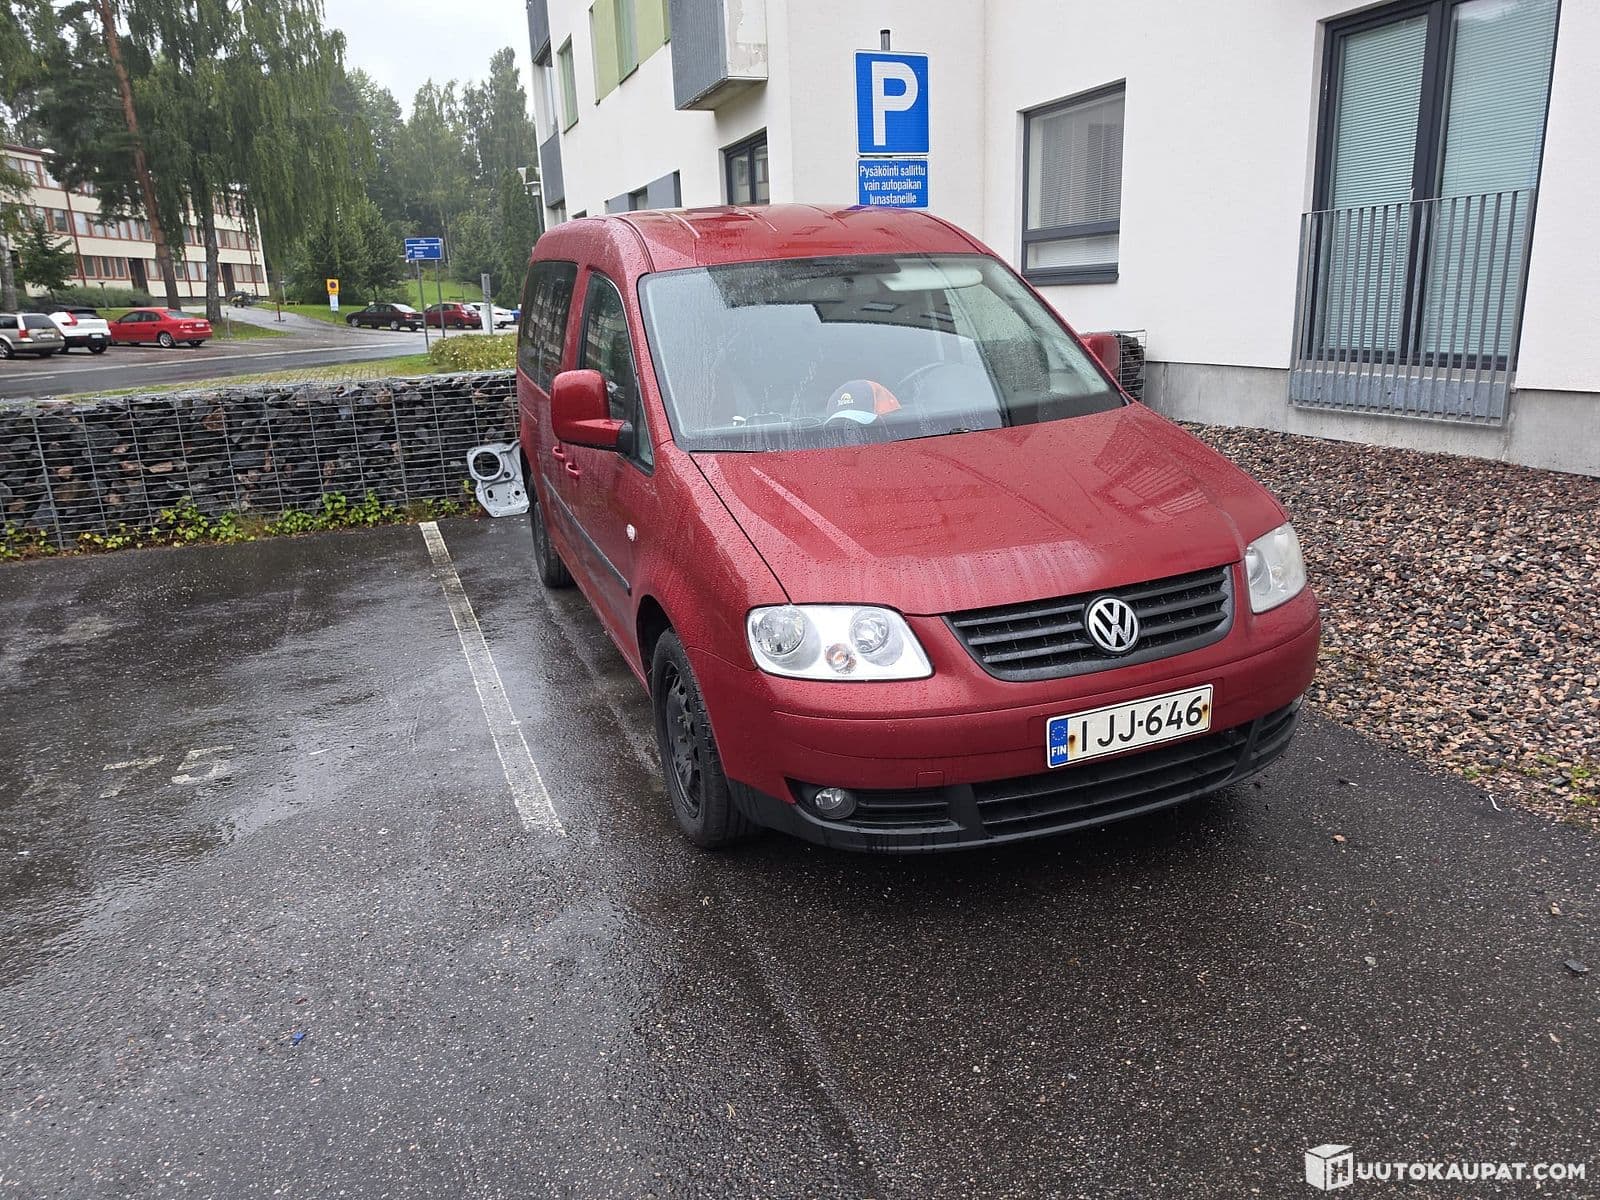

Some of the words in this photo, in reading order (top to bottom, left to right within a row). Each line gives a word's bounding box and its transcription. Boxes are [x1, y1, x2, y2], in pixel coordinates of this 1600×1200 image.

[872, 61, 918, 146] P
[859, 165, 899, 178] Pysäköinti
[900, 165, 926, 176] sallittu
[863, 180, 880, 191] vain
[881, 179, 922, 191] autopaikan
[869, 193, 917, 205] lunastaneille
[1090, 599, 1136, 650] VW
[1081, 695, 1203, 752] IJJ-646
[1051, 744, 1067, 757] FIN
